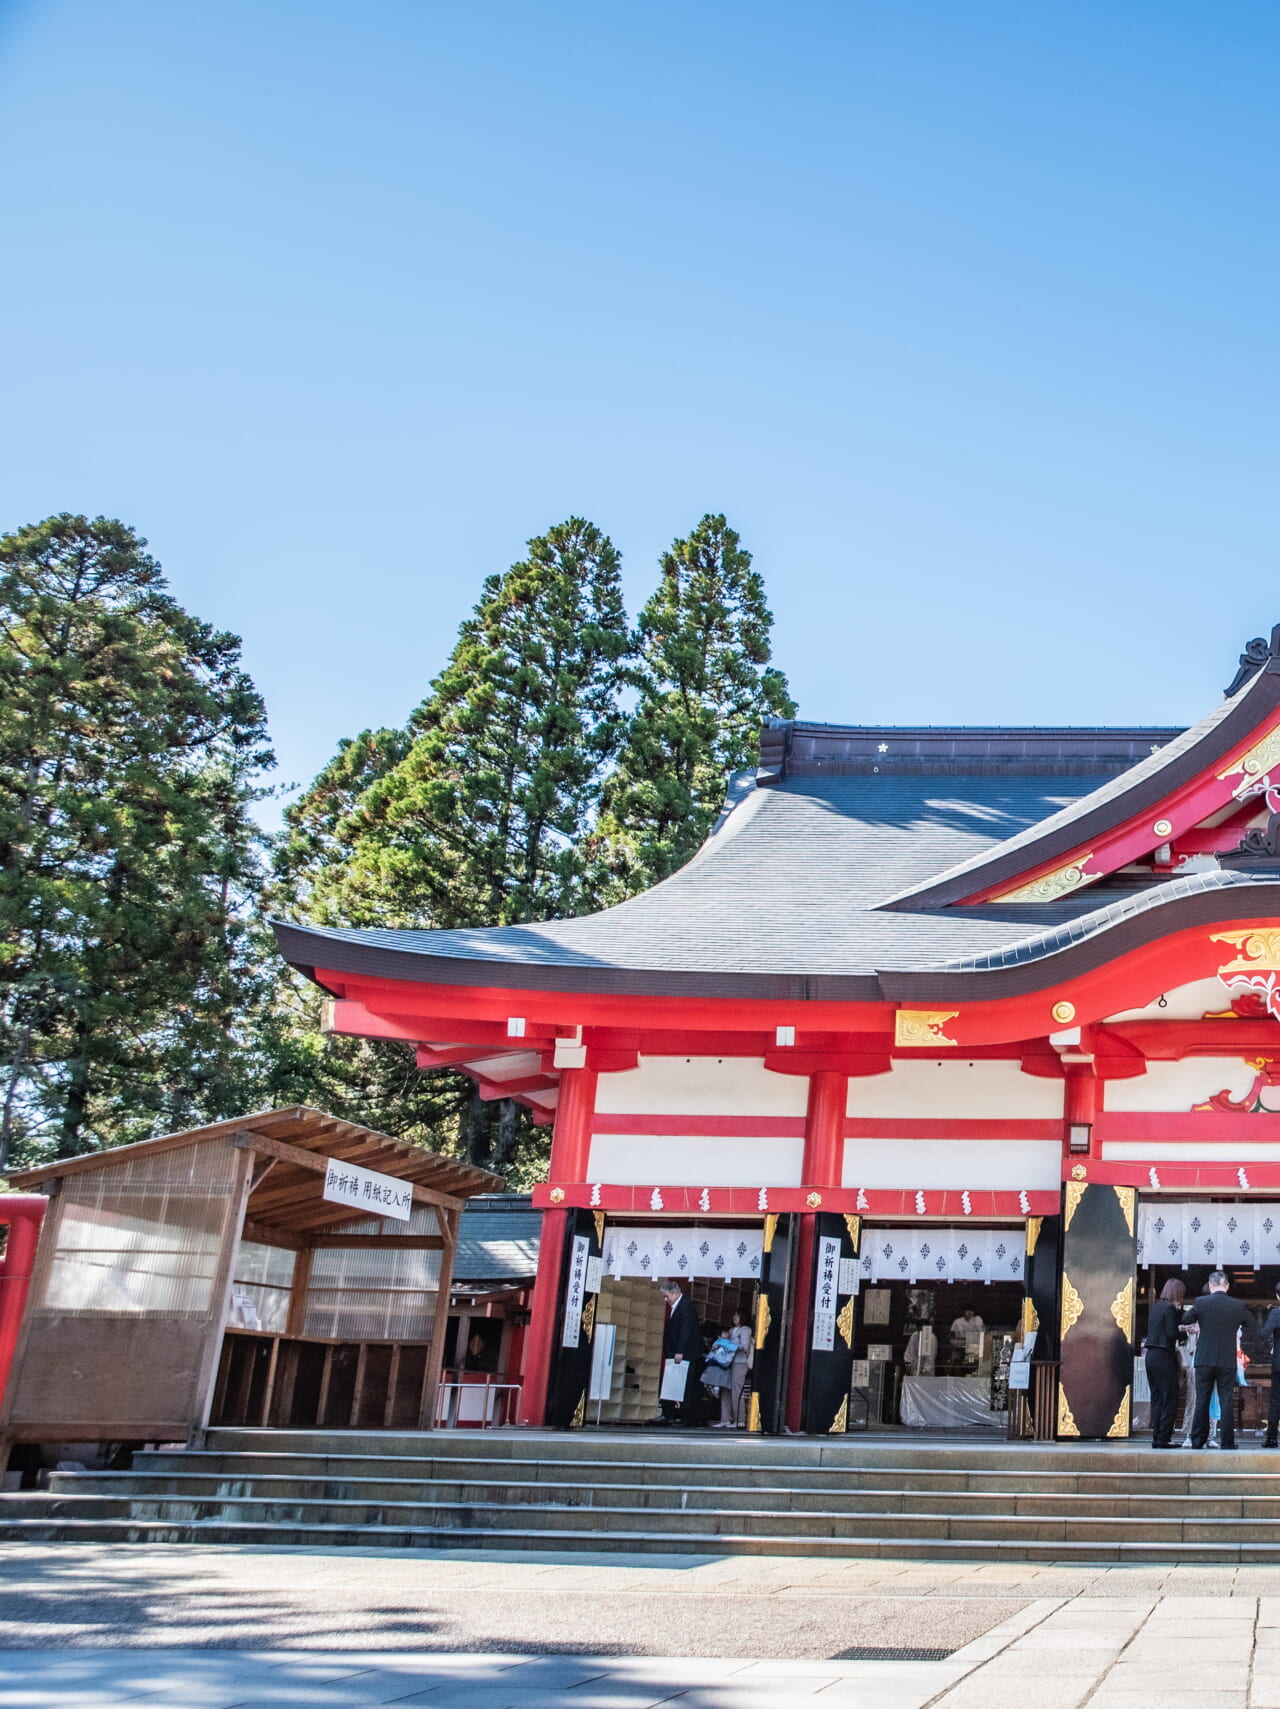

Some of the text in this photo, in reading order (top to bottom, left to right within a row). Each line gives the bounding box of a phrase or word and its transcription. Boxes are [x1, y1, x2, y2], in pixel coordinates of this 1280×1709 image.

[362, 1181, 412, 1211] 用紙記入所
[821, 1242, 836, 1309] 御祈祷受付
